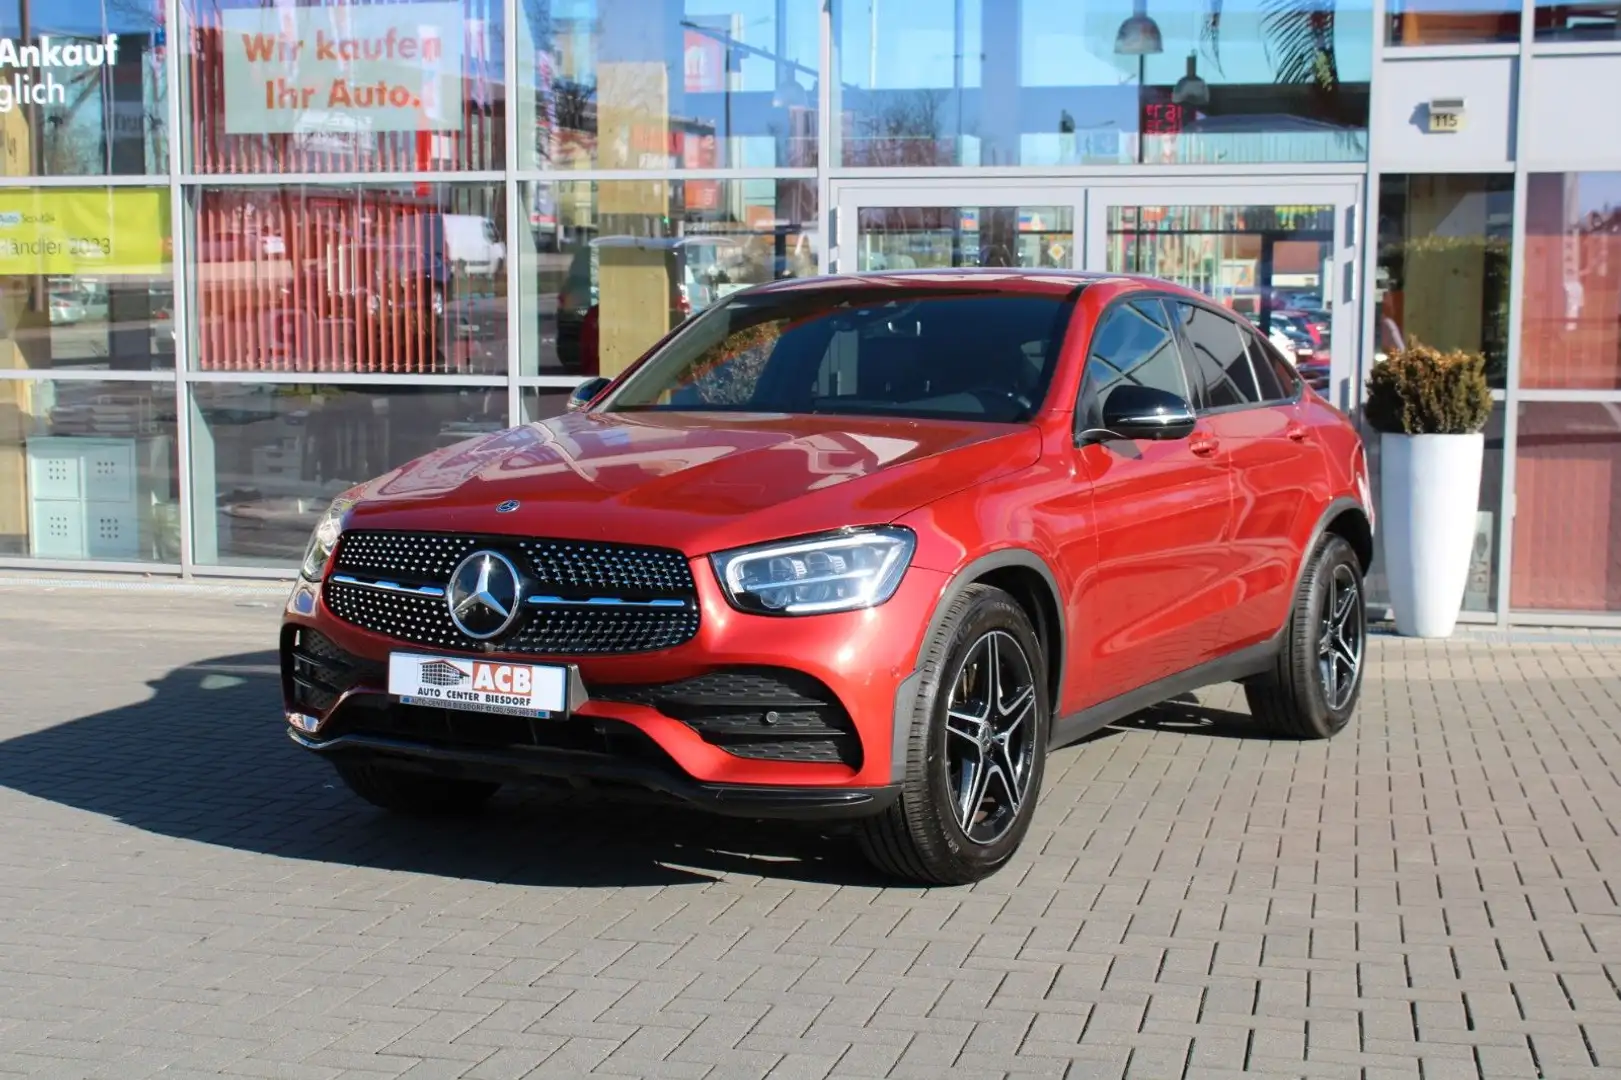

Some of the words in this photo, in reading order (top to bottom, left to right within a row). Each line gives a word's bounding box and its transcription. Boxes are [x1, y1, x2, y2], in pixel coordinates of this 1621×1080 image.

[0, 33, 118, 68] Ankauf
[242, 33, 304, 63] Wir
[316, 28, 441, 62] kaufen
[0, 72, 65, 112] glich
[266, 78, 315, 109] Ihr
[327, 79, 421, 109] Auto.
[1435, 114, 1457, 127] 115
[69, 237, 111, 255] 2023
[474, 663, 532, 693] ACB
[417, 687, 441, 697] AUTO
[446, 690, 479, 701] CENTER
[485, 694, 532, 706] BIESDORF
